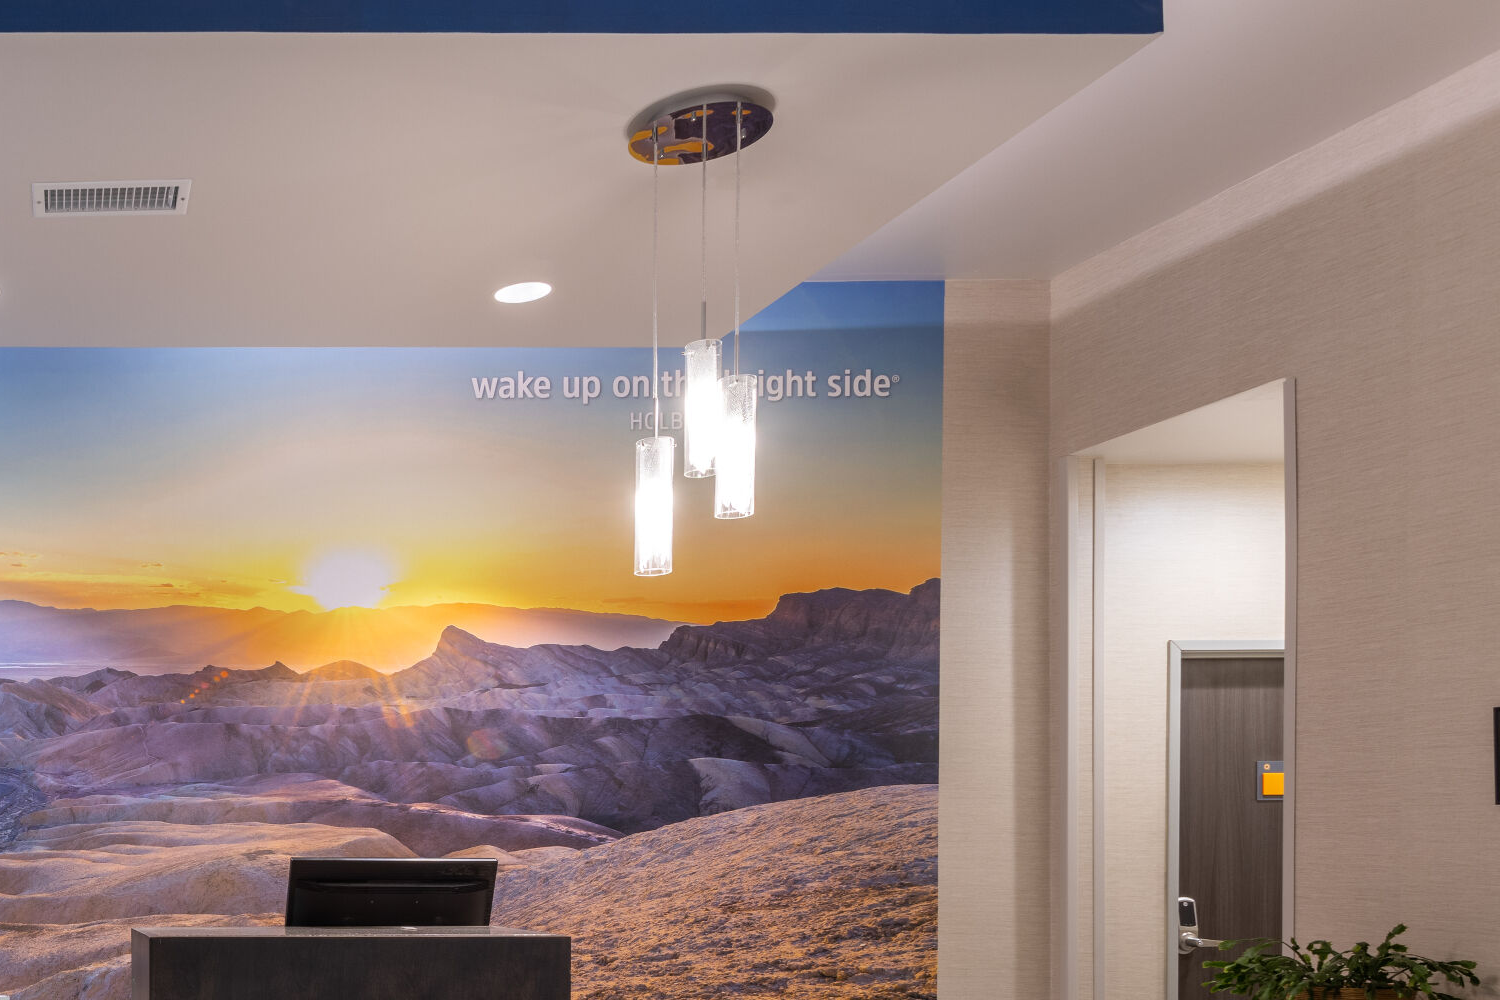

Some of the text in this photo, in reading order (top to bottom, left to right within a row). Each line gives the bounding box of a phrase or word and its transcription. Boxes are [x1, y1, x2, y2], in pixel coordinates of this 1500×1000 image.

[471, 371, 551, 400] wake
[562, 374, 602, 404] up
[612, 374, 651, 398] on
